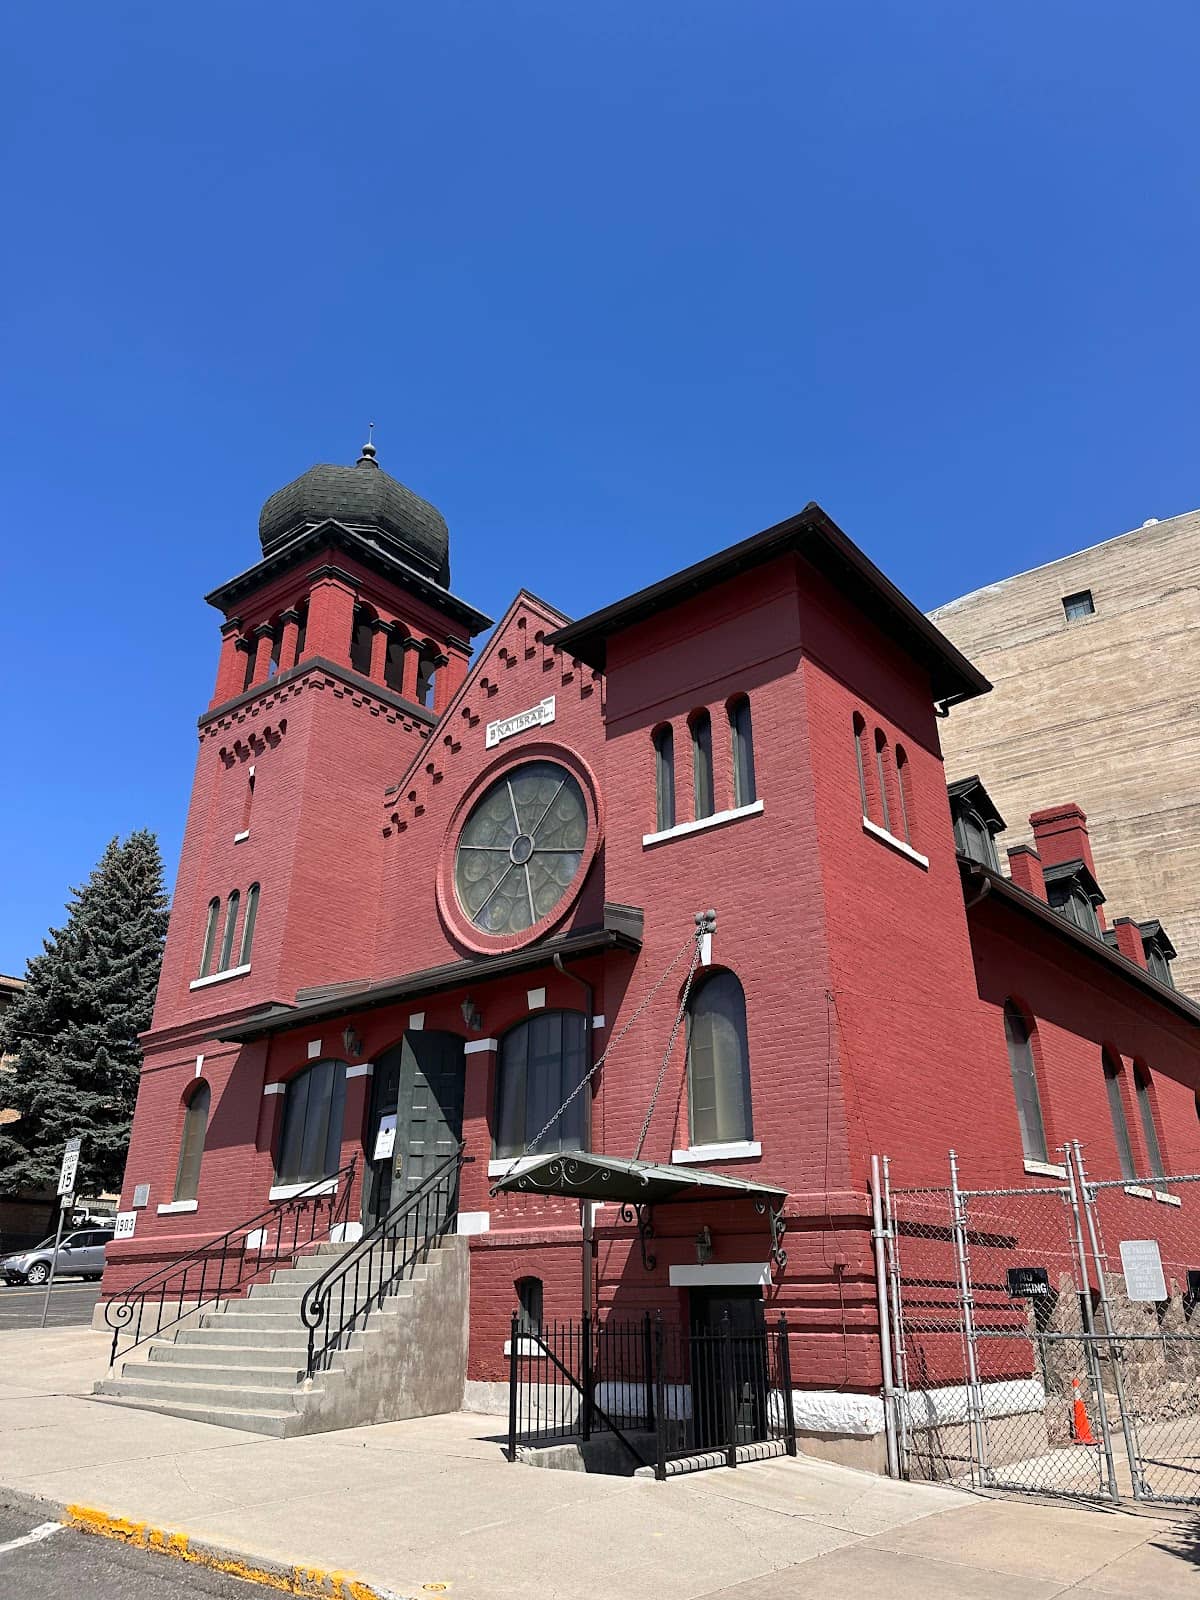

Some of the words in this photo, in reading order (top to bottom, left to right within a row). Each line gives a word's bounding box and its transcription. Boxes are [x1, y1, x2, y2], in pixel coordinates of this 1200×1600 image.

[61, 1172, 72, 1189] 15
[116, 1218, 134, 1232] 1903
[1020, 1271, 1033, 1282] NO
